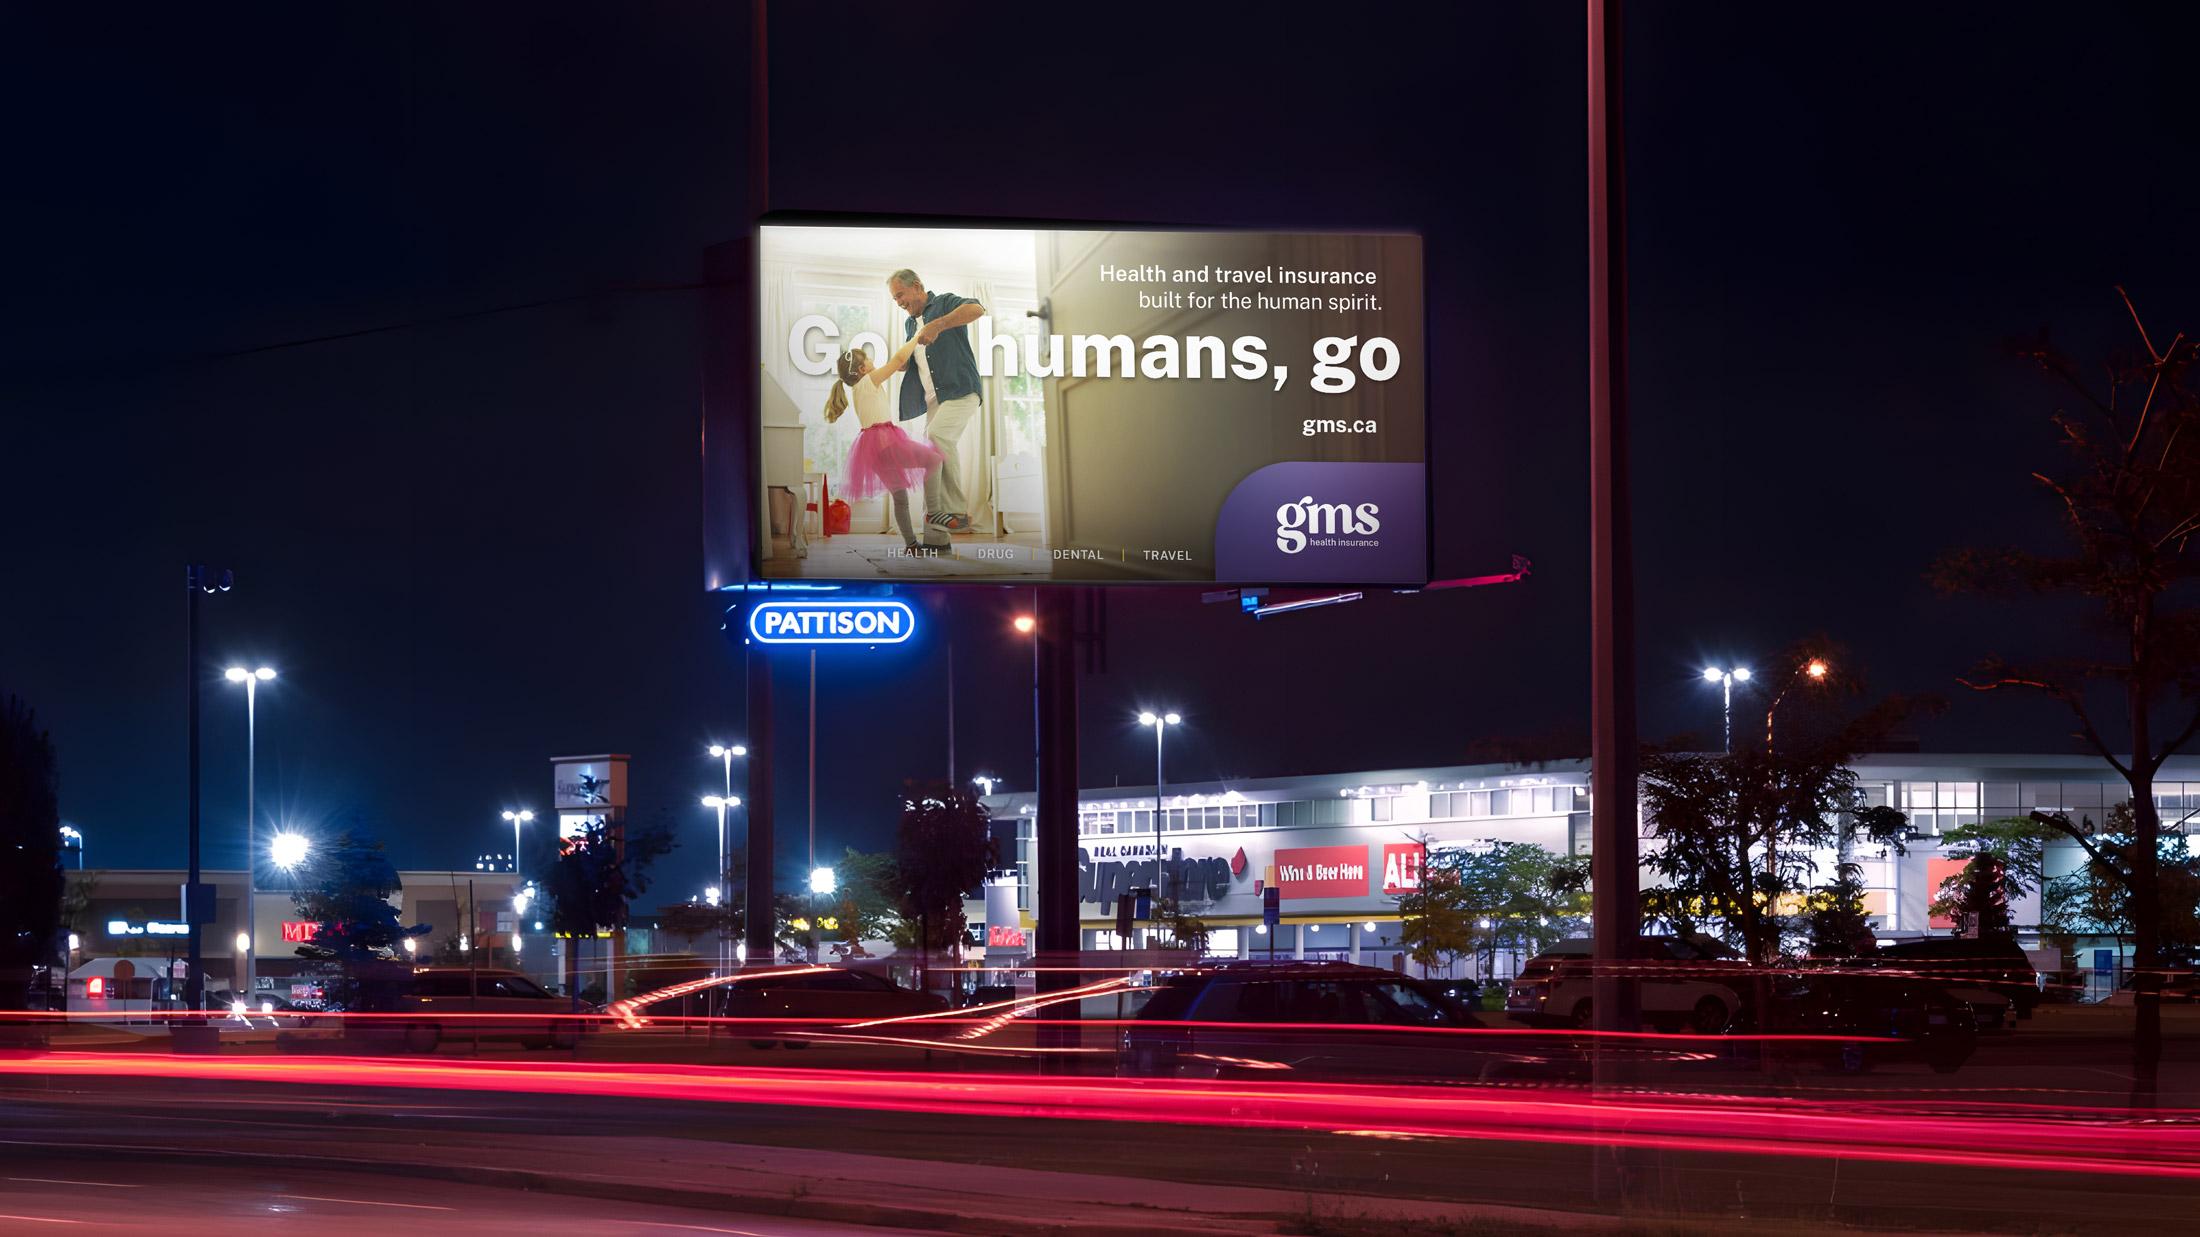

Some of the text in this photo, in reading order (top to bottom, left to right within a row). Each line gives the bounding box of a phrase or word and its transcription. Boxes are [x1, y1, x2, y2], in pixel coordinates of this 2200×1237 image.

[1100, 265, 1377, 285] Health and travel insurance
[1139, 291, 1383, 313] built for the human spirit.
[788, 314, 1401, 394] Go humans, go
[1302, 418, 1377, 437] gms.ca
[1276, 495, 1380, 554] gms
[1309, 538, 1380, 547] health insurance
[887, 547, 1193, 561] HEALTH DRUG DENTAL TRAVEL
[765, 611, 900, 634] PATTISON
